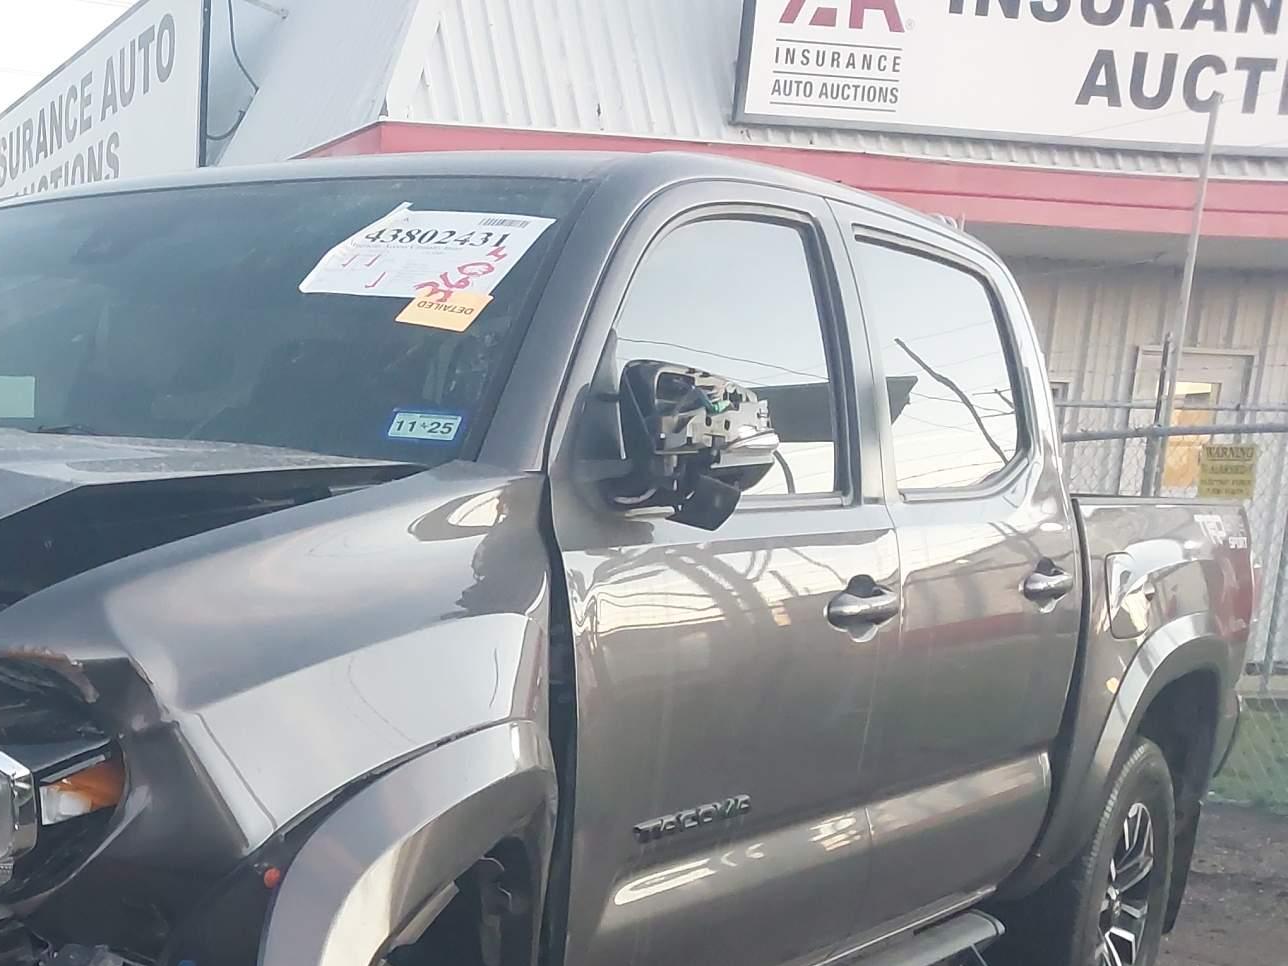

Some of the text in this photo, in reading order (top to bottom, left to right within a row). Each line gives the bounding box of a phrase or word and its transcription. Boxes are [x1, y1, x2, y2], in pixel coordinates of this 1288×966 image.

[947, 0, 1283, 35] URAN
[99, 12, 176, 121] AUTO
[774, 46, 902, 73] INSURANCE
[770, 78, 900, 105] AUTO AUCTIONS
[15, 131, 121, 196] TIONS
[364, 227, 511, 248] 43802431
[416, 300, 475, 316] DETAILED
